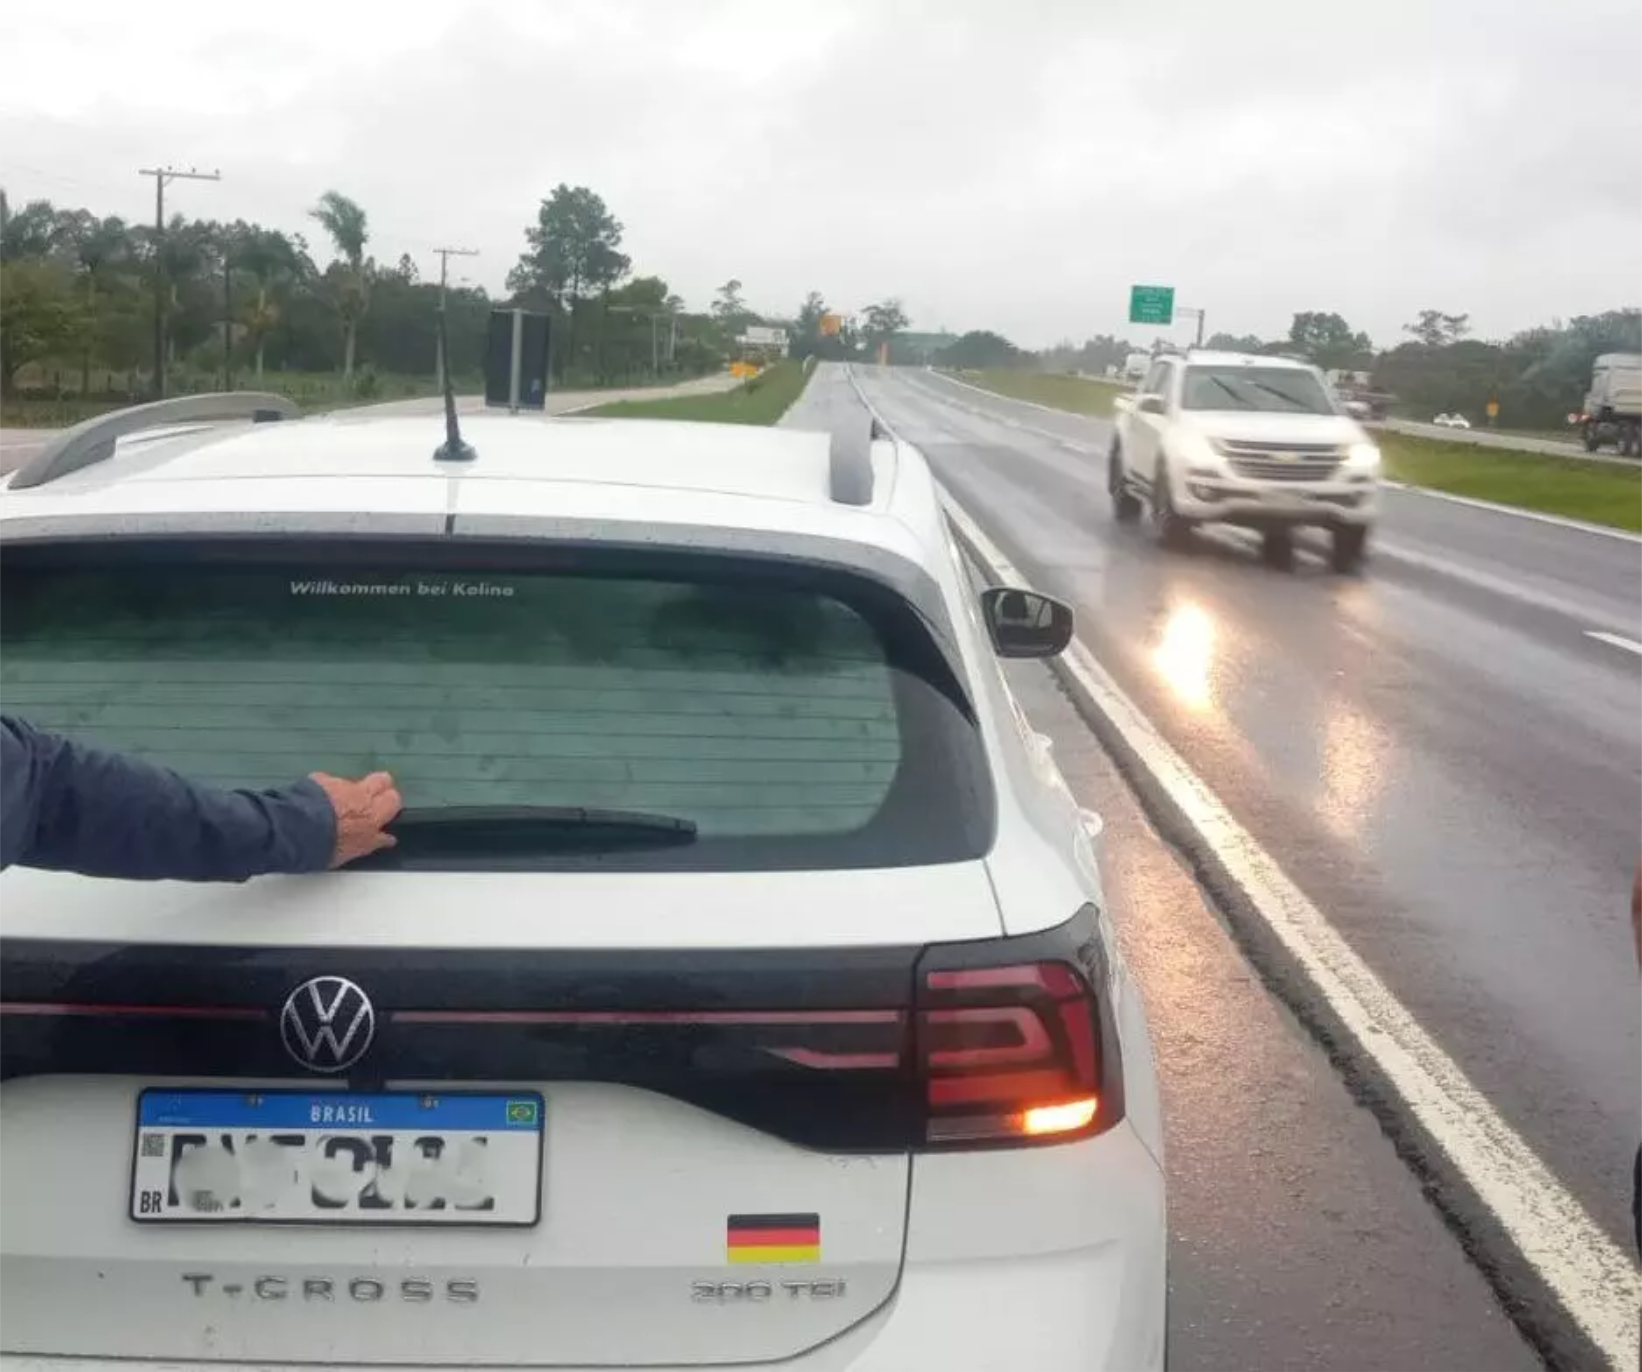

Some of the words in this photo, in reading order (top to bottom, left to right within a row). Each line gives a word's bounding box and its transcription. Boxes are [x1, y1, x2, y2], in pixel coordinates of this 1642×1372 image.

[290, 581, 410, 595] Willkommen
[417, 582, 446, 596] bei
[310, 1104, 373, 1123] BRASIL
[140, 1190, 161, 1213] BR
[182, 1272, 479, 1301] T-CROSS
[692, 1281, 772, 1302] 200
